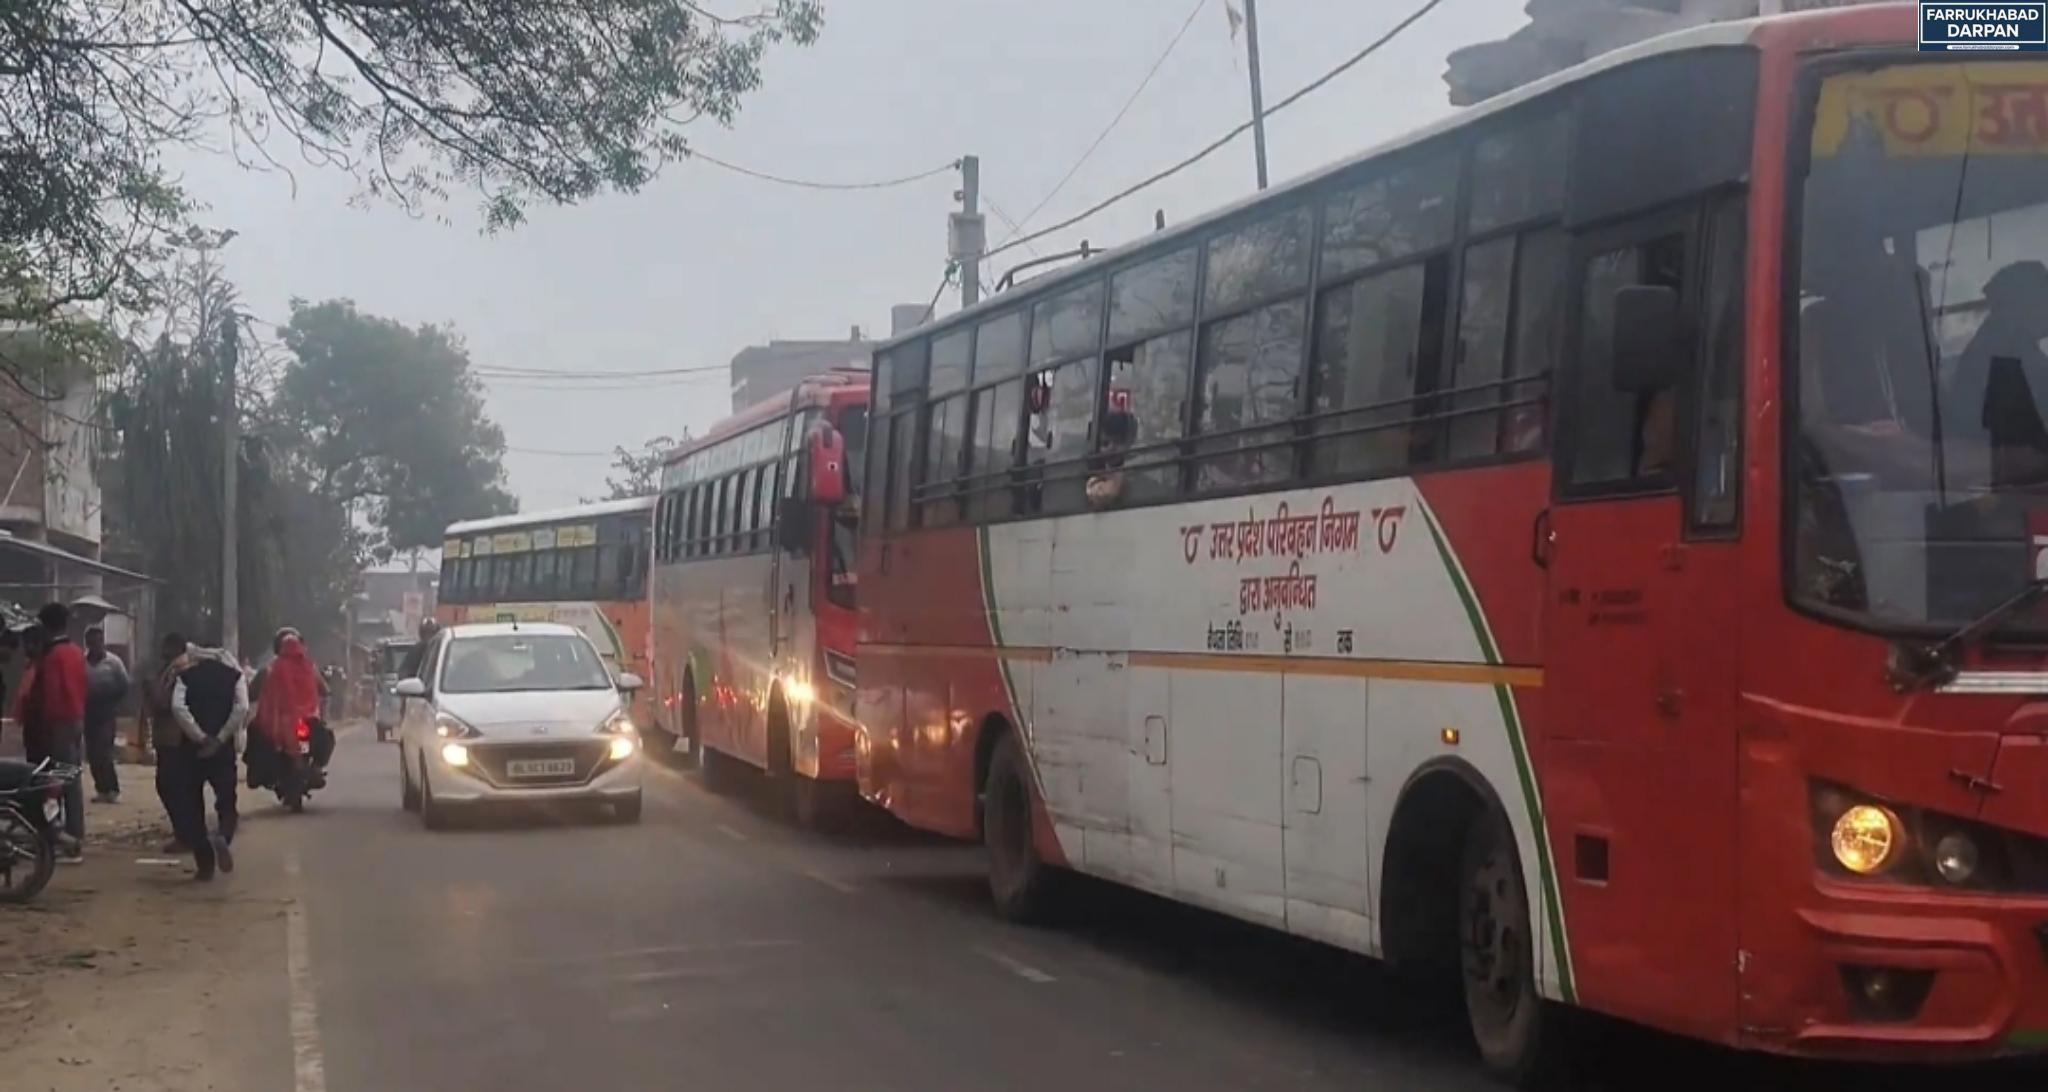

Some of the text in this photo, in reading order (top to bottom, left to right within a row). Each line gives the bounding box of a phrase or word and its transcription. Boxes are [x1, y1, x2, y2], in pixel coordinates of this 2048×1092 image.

[1209, 496, 1360, 565] उत्तर प्रदेश परिवहन निगम
[1240, 577, 1261, 615] द्वारा
